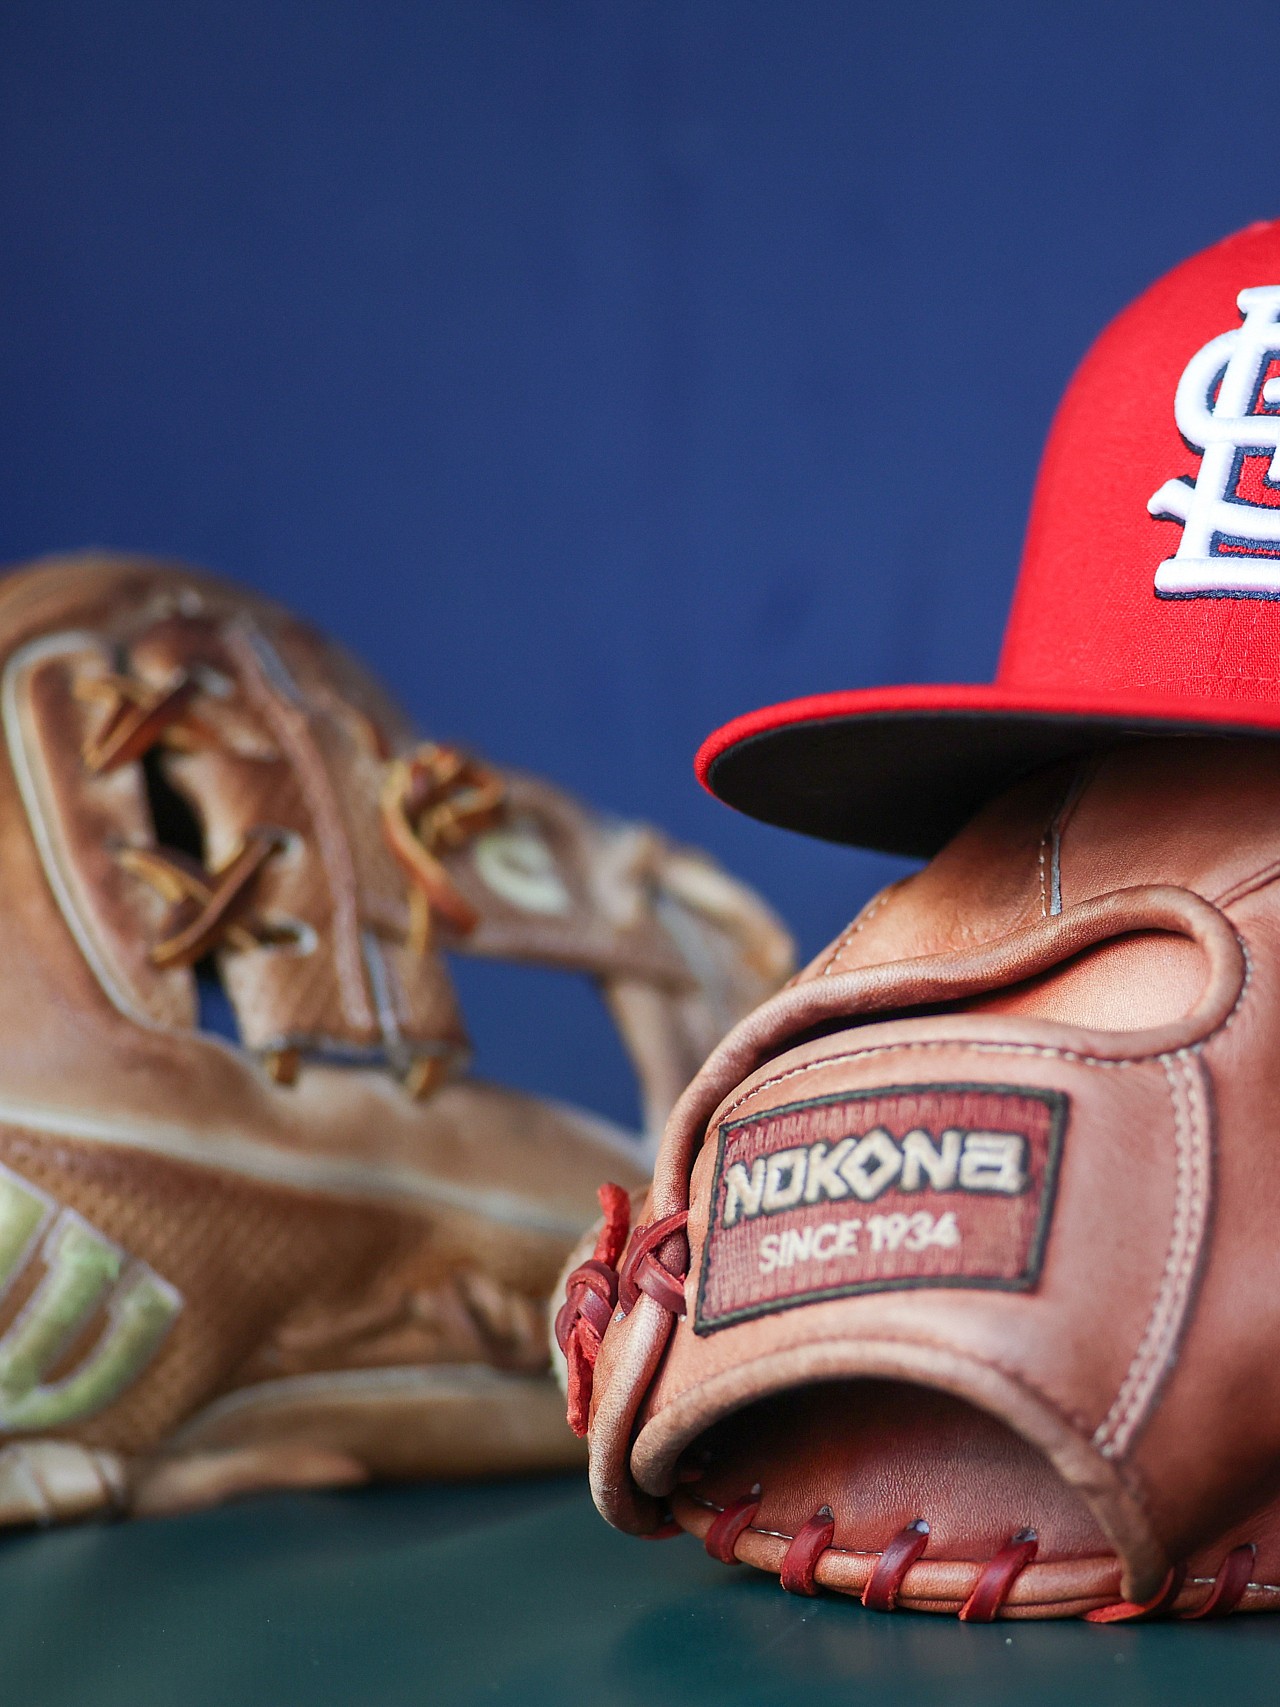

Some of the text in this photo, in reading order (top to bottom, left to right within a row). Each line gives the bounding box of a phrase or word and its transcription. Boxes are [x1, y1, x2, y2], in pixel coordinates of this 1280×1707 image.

[723, 1128, 1030, 1227] NOKONA
[759, 1211, 961, 1272] SINCE 1934
